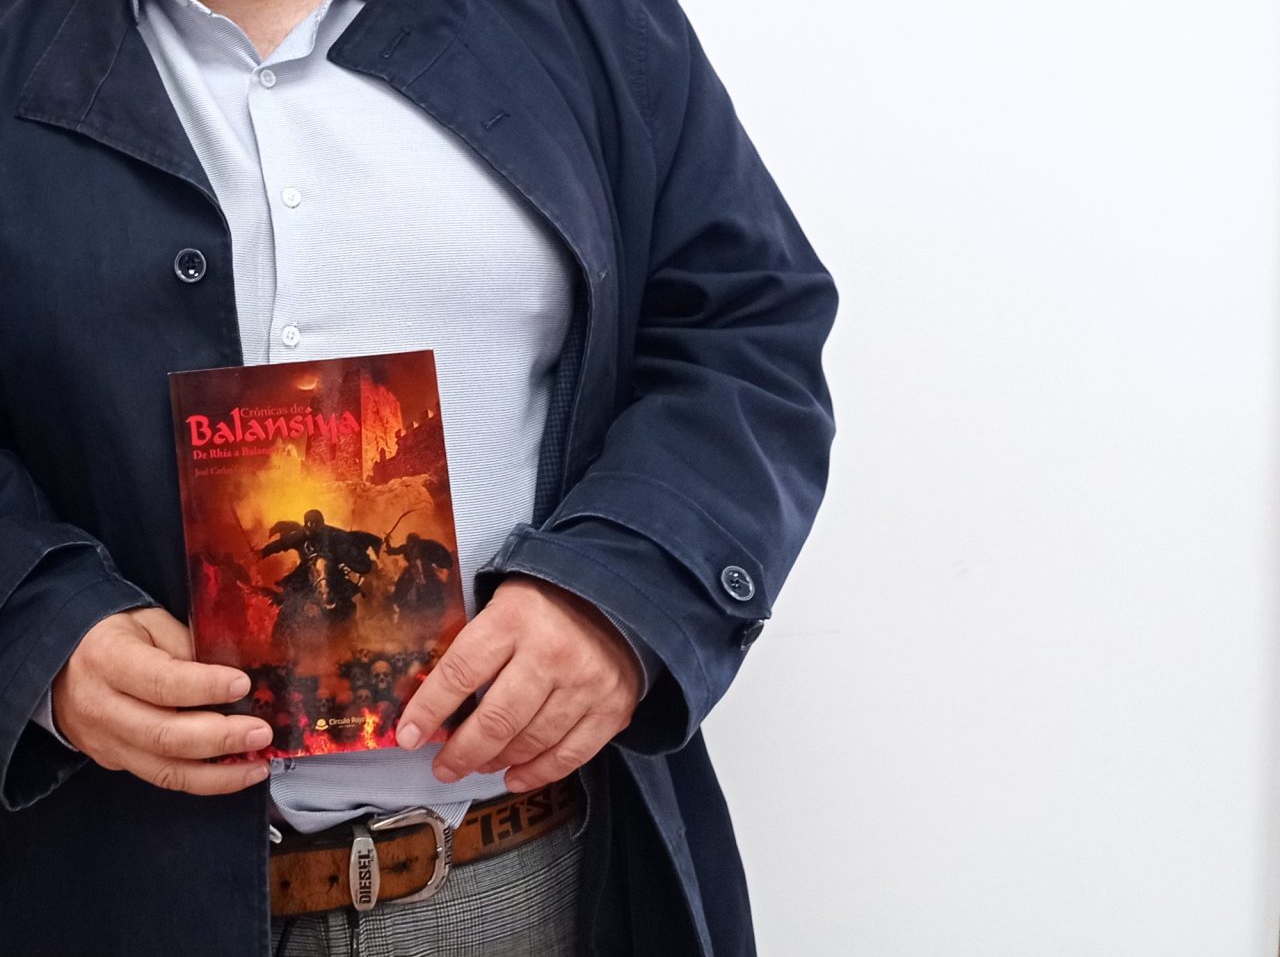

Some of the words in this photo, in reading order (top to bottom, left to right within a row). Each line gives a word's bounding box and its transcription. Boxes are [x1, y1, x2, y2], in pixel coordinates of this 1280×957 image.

[240, 407, 288, 418] Crónicas
[291, 403, 305, 414] de
[186, 406, 360, 446] Balansiya
[193, 449, 207, 460] De
[358, 849, 372, 904] DIESEL
